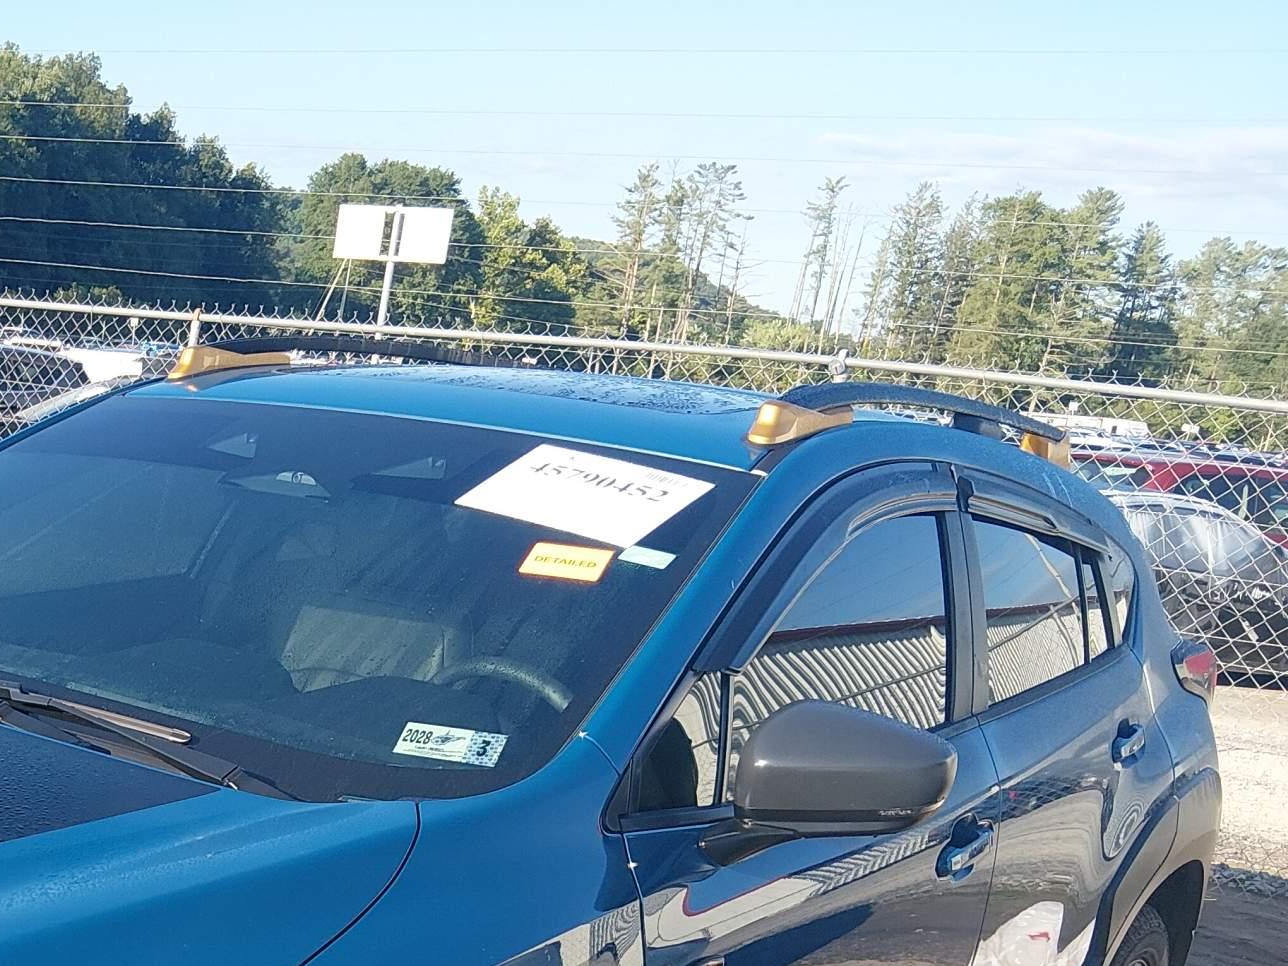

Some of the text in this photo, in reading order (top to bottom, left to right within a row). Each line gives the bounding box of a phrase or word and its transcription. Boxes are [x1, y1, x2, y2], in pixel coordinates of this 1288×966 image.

[529, 462, 670, 502] 45790452
[534, 554, 598, 569] DETAILED
[402, 728, 434, 745] 2028
[476, 739, 492, 757] 3
